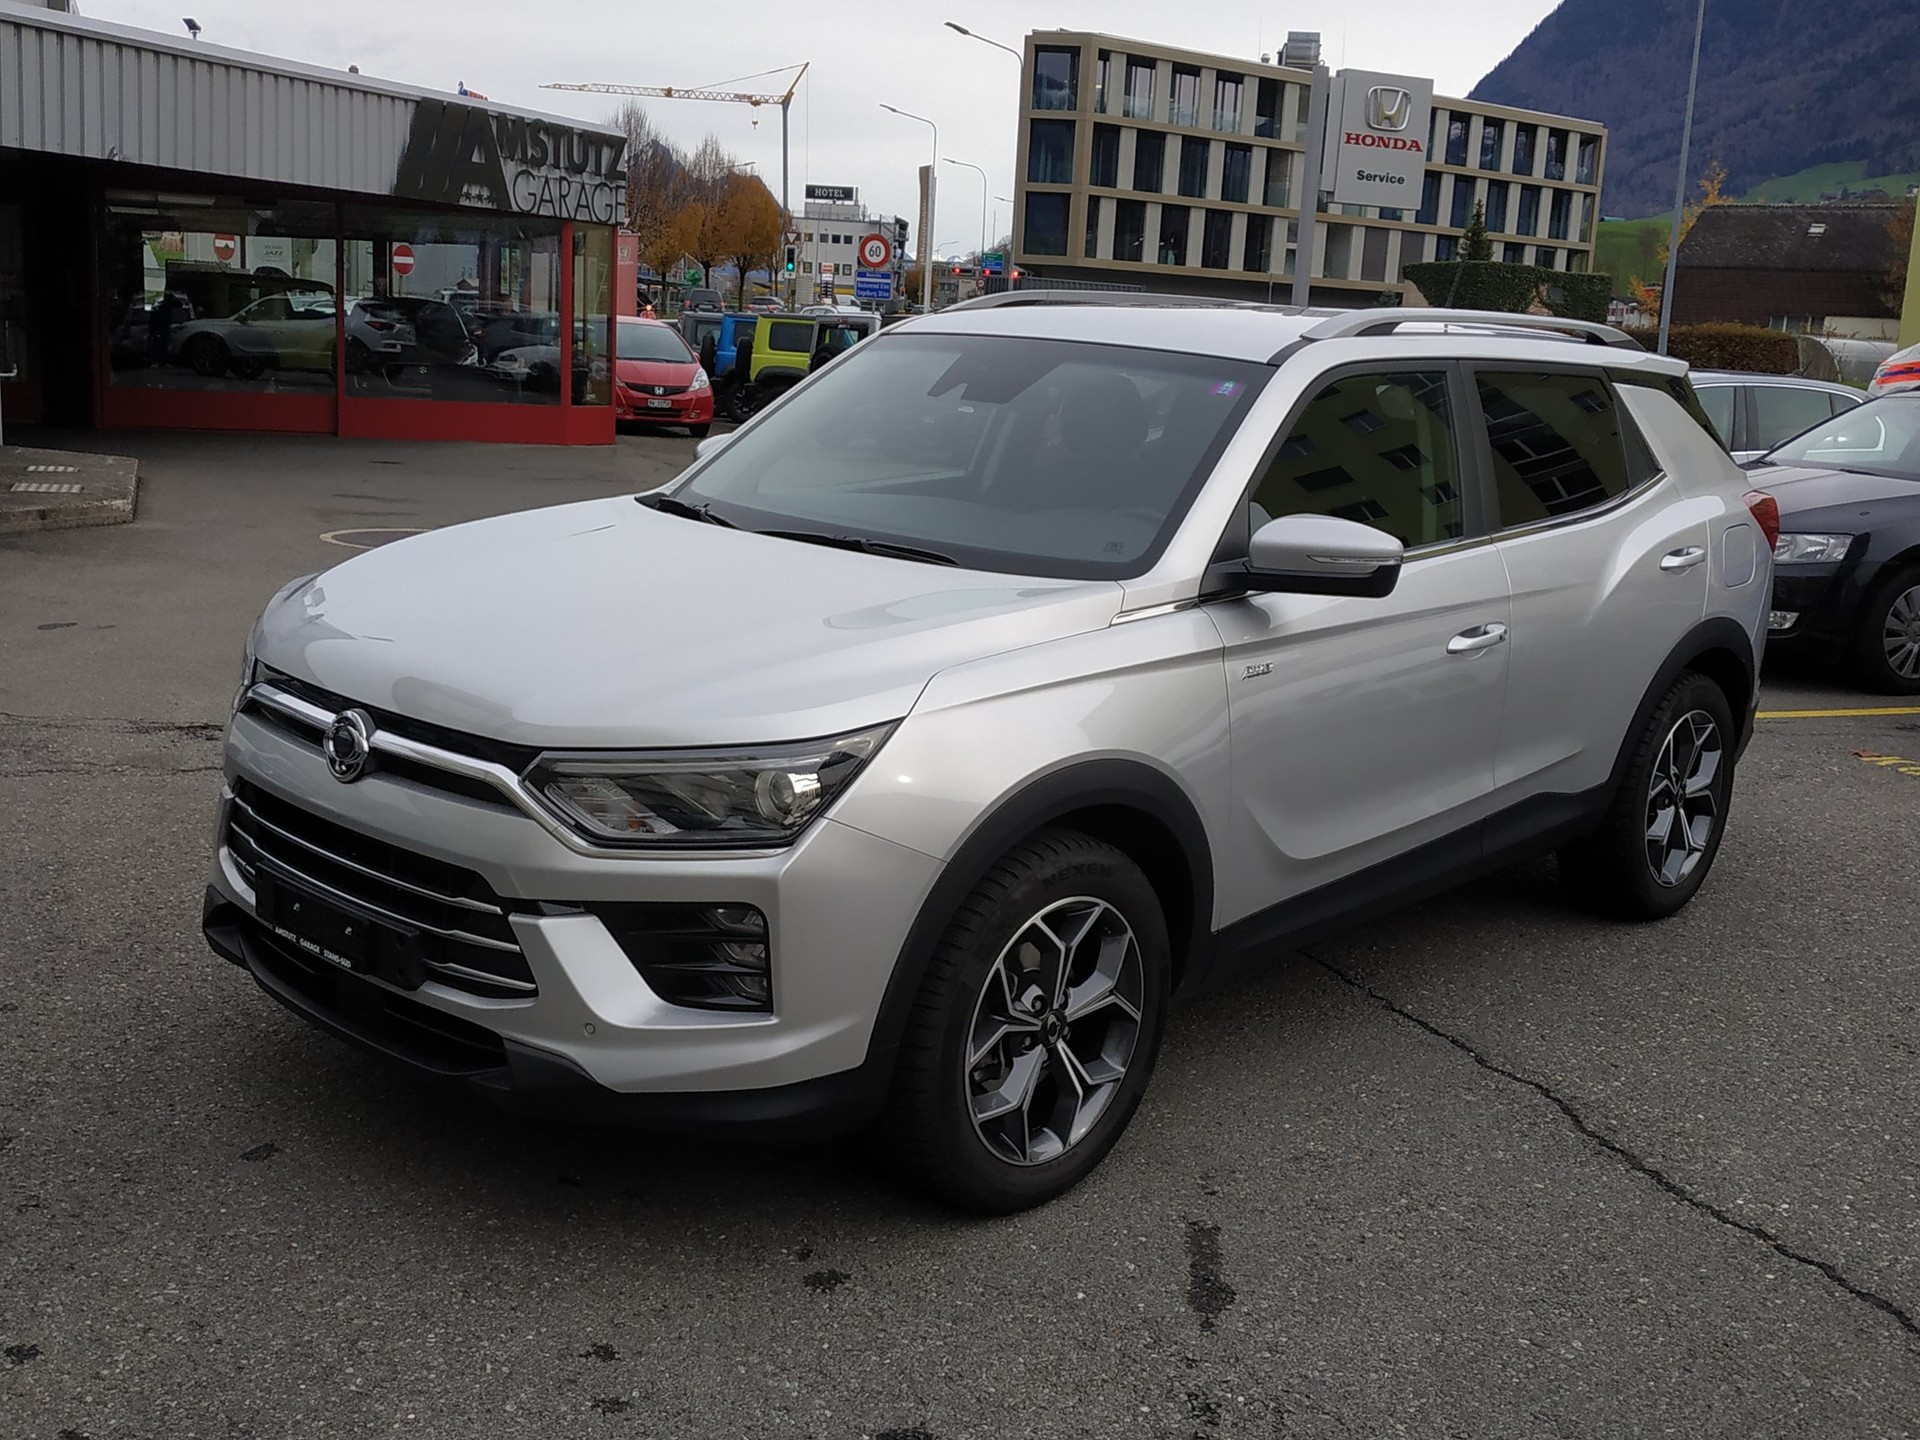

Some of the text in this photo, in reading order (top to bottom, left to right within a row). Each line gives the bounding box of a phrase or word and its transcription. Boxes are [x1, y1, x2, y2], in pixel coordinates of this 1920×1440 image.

[1344, 132, 1424, 152] HONDA
[456, 102, 628, 211] AMSTUTZ
[1356, 169, 1405, 185] Service
[513, 169, 628, 226] GARAGE
[814, 188, 845, 198] HOTEL
[868, 246, 882, 258] 60
[1042, 862, 1113, 889] NEXEN
[299, 938, 321, 954] GARAGE
